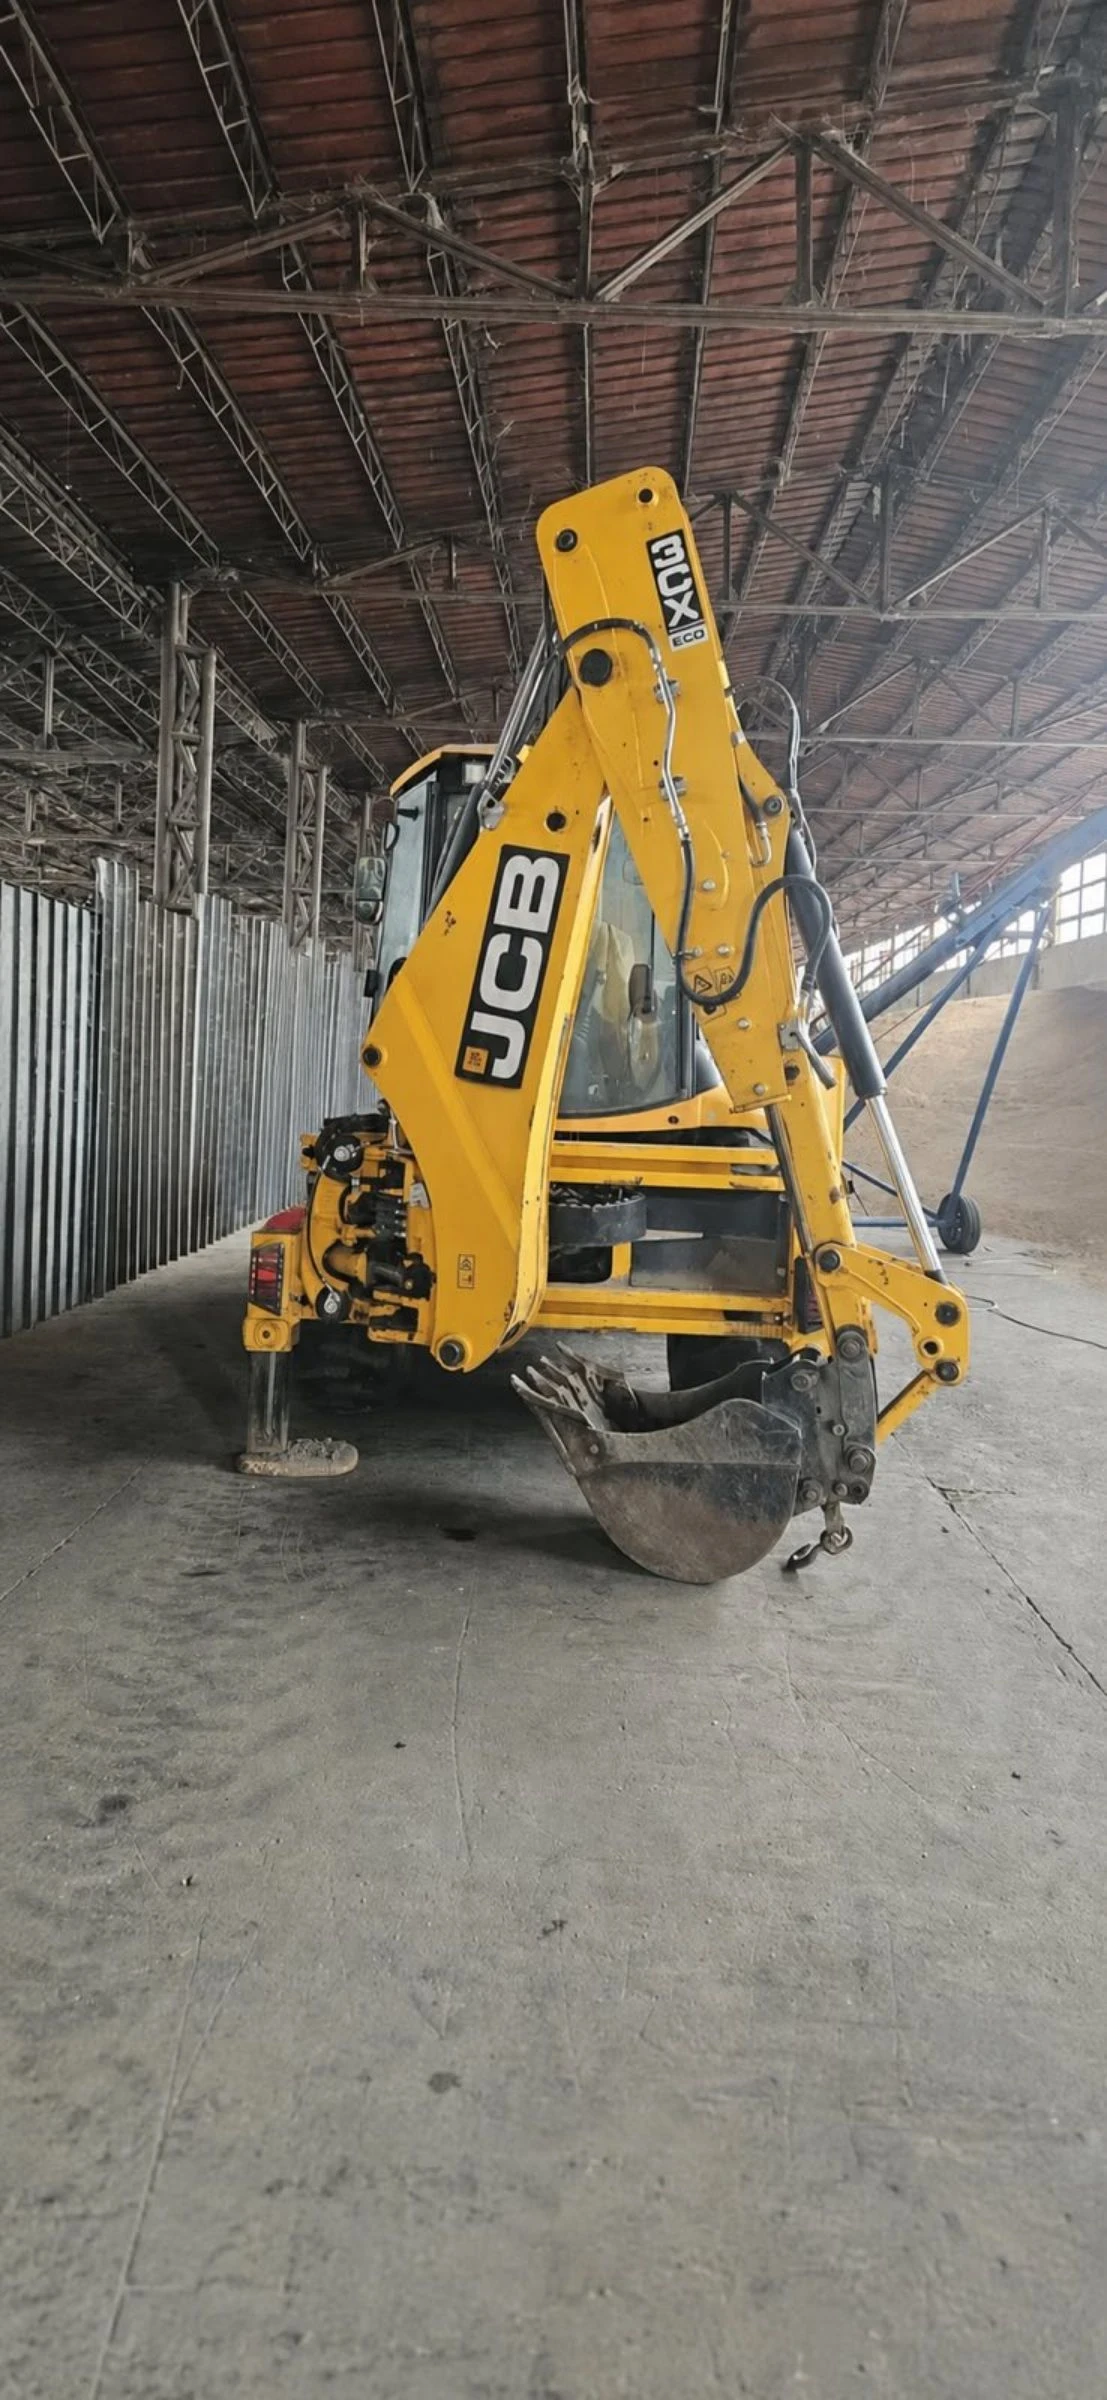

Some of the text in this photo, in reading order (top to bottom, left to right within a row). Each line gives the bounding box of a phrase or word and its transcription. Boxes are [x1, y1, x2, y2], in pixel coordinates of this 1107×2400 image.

[651, 535, 699, 628] 3CX
[673, 631, 705, 647] ECO
[470, 855, 560, 1079] JCB
